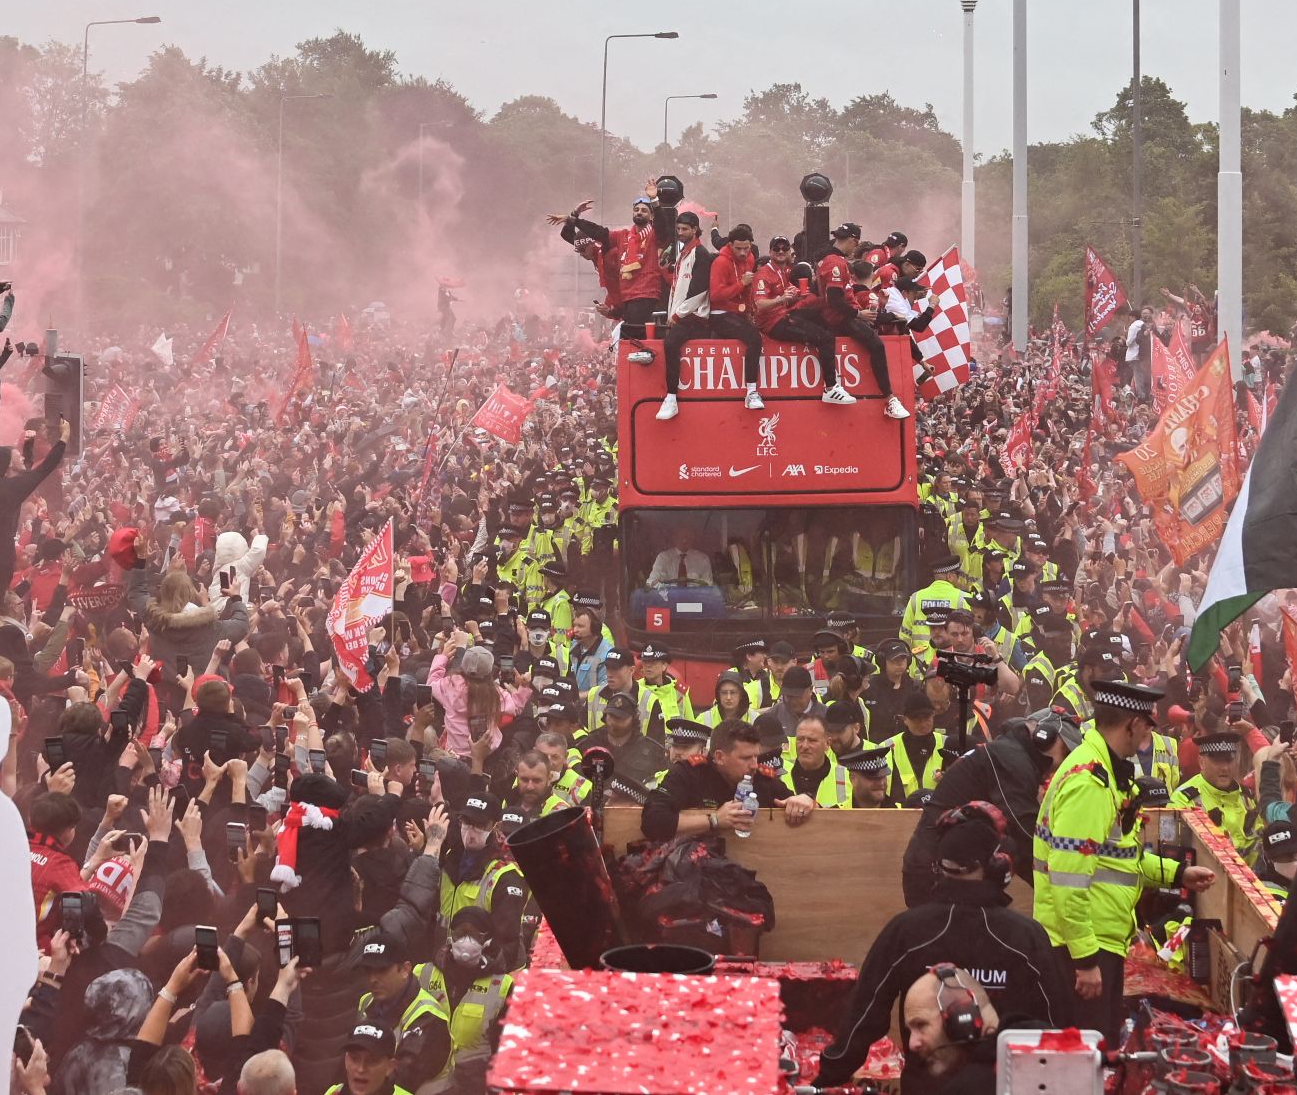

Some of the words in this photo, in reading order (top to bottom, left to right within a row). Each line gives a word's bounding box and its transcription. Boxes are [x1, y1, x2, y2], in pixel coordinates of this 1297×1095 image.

[685, 347, 765, 356] PREMIR
[779, 344, 847, 354] LEAE
[691, 471, 722, 479] chartered
[782, 464, 806, 476] AXA
[824, 465, 859, 475] Expedia
[921, 599, 951, 609] POLICE
[653, 614, 663, 626] 5
